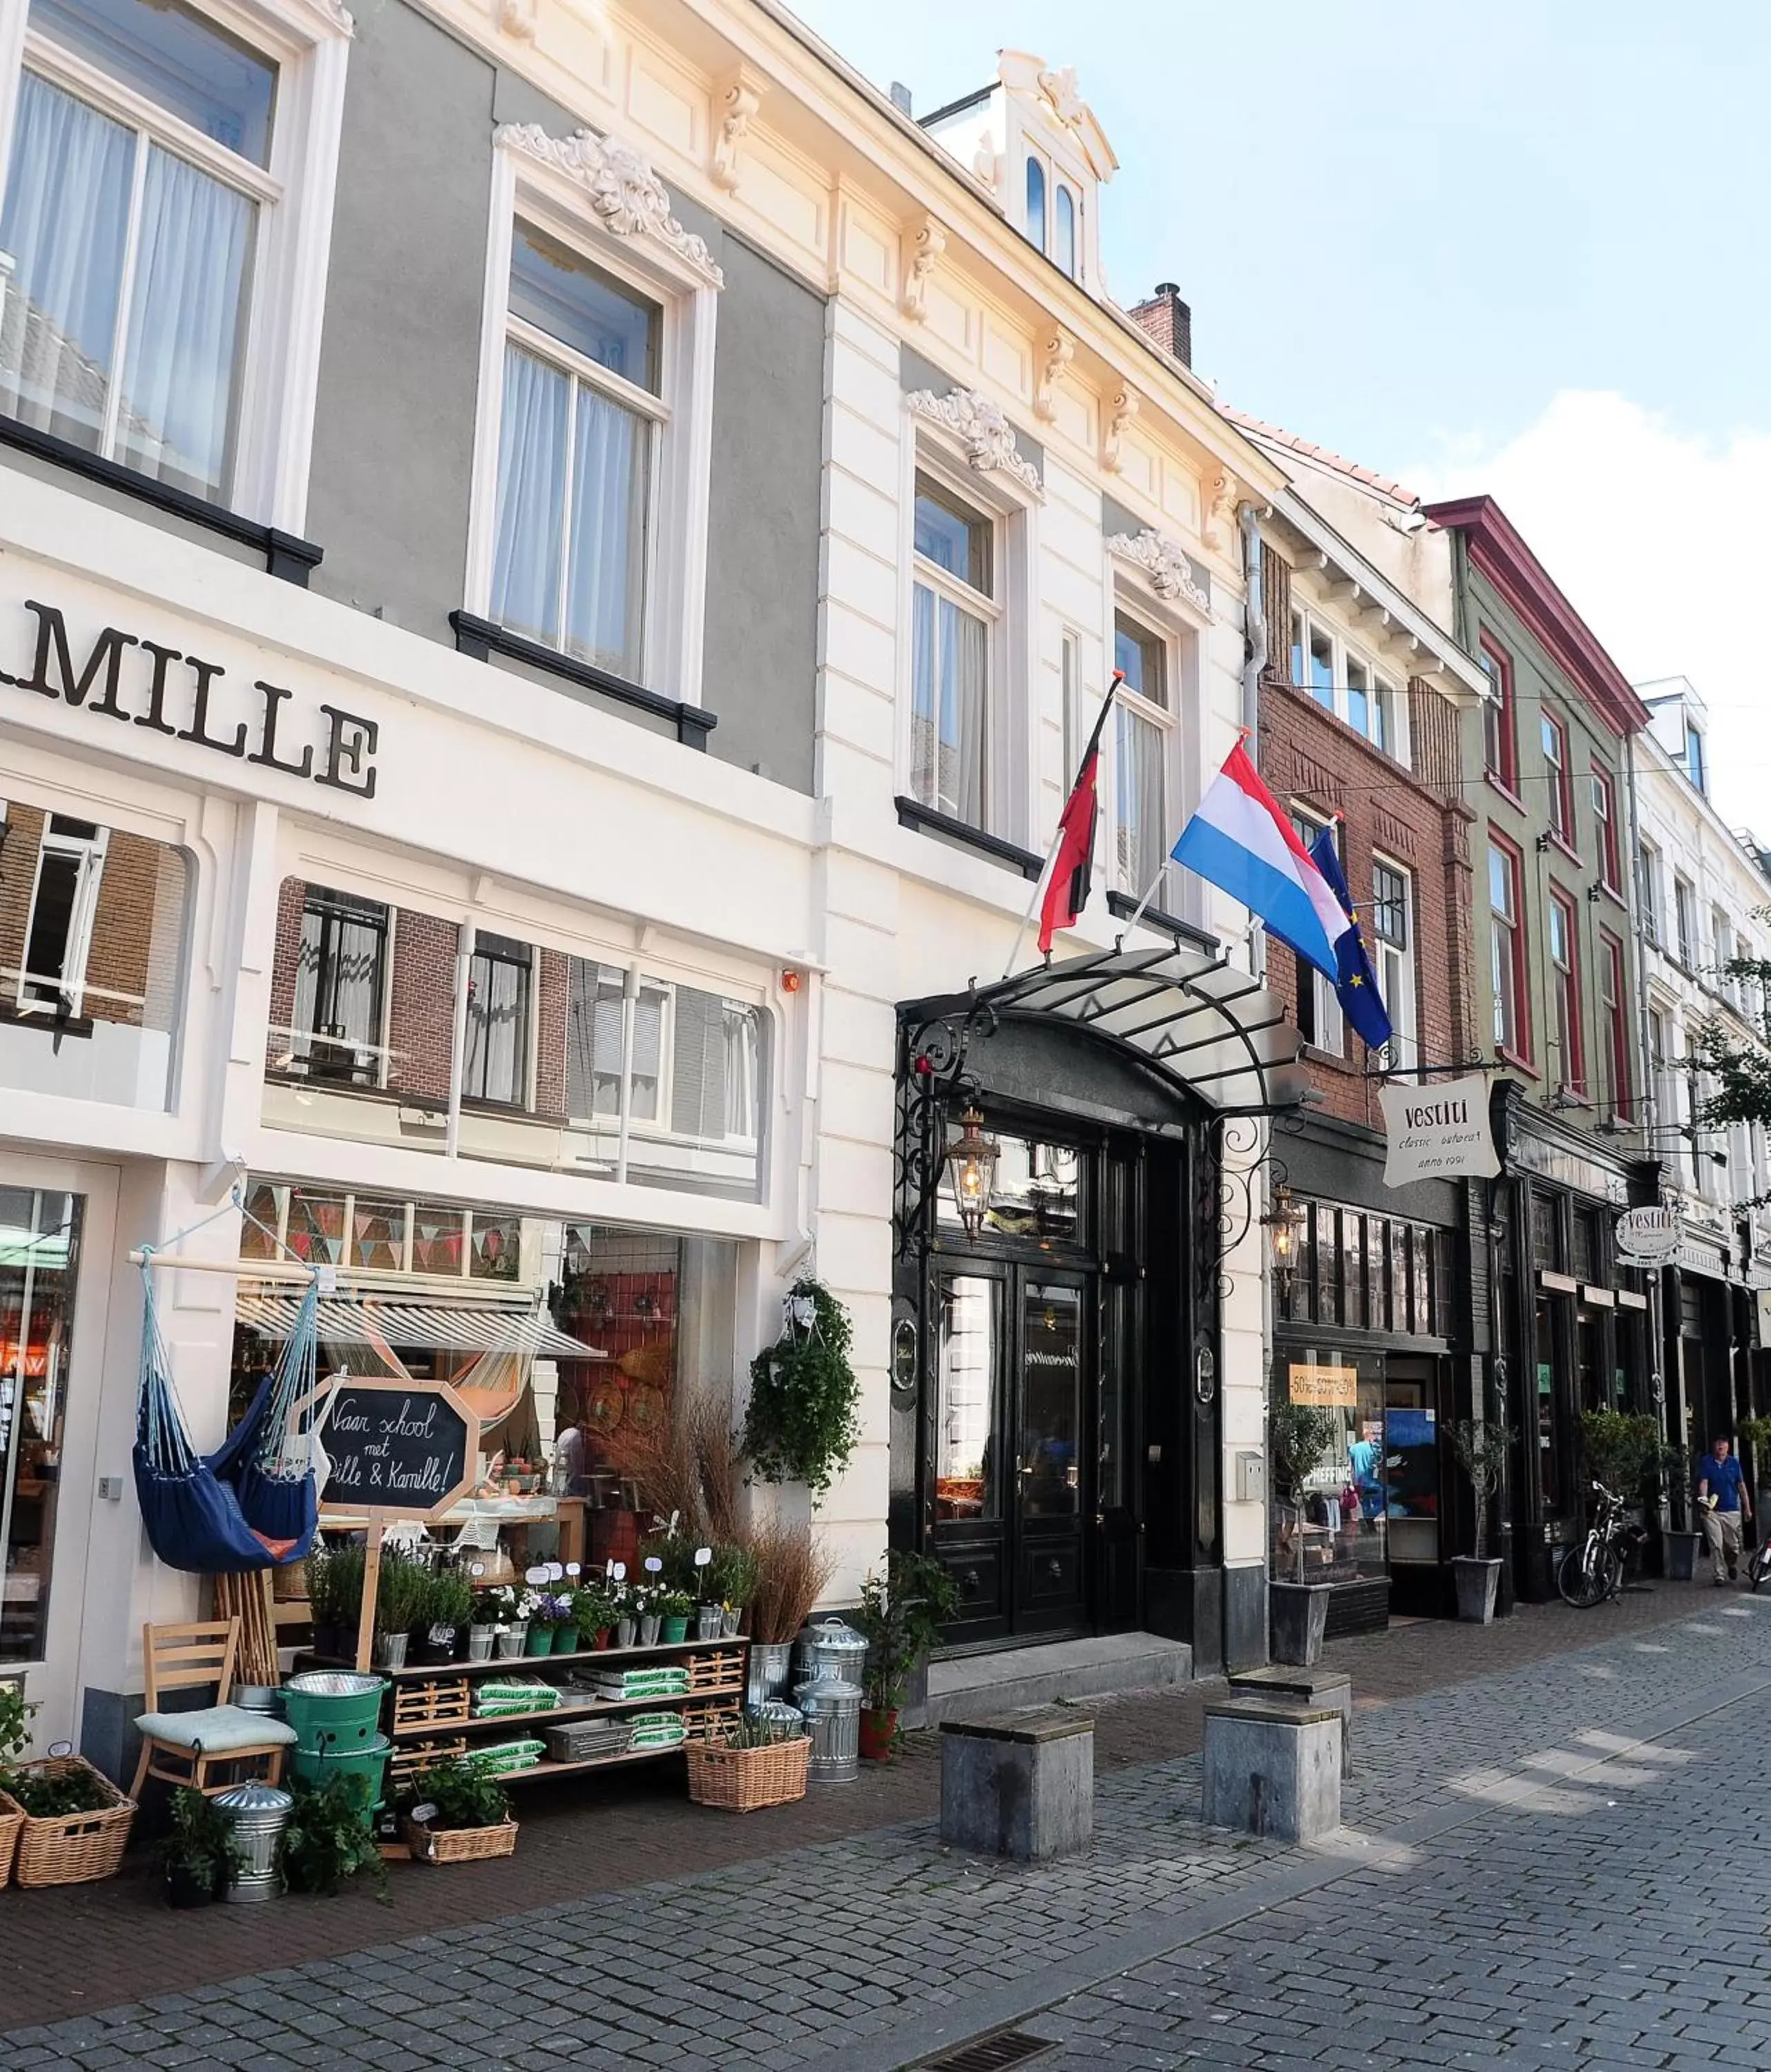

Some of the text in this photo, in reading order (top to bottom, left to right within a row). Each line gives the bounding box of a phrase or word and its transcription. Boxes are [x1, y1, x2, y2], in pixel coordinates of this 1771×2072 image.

[0, 599, 379, 799] MILLE
[379, 1399, 437, 1439] school
[363, 1435, 390, 1457] met
[370, 1462, 382, 1485] &
